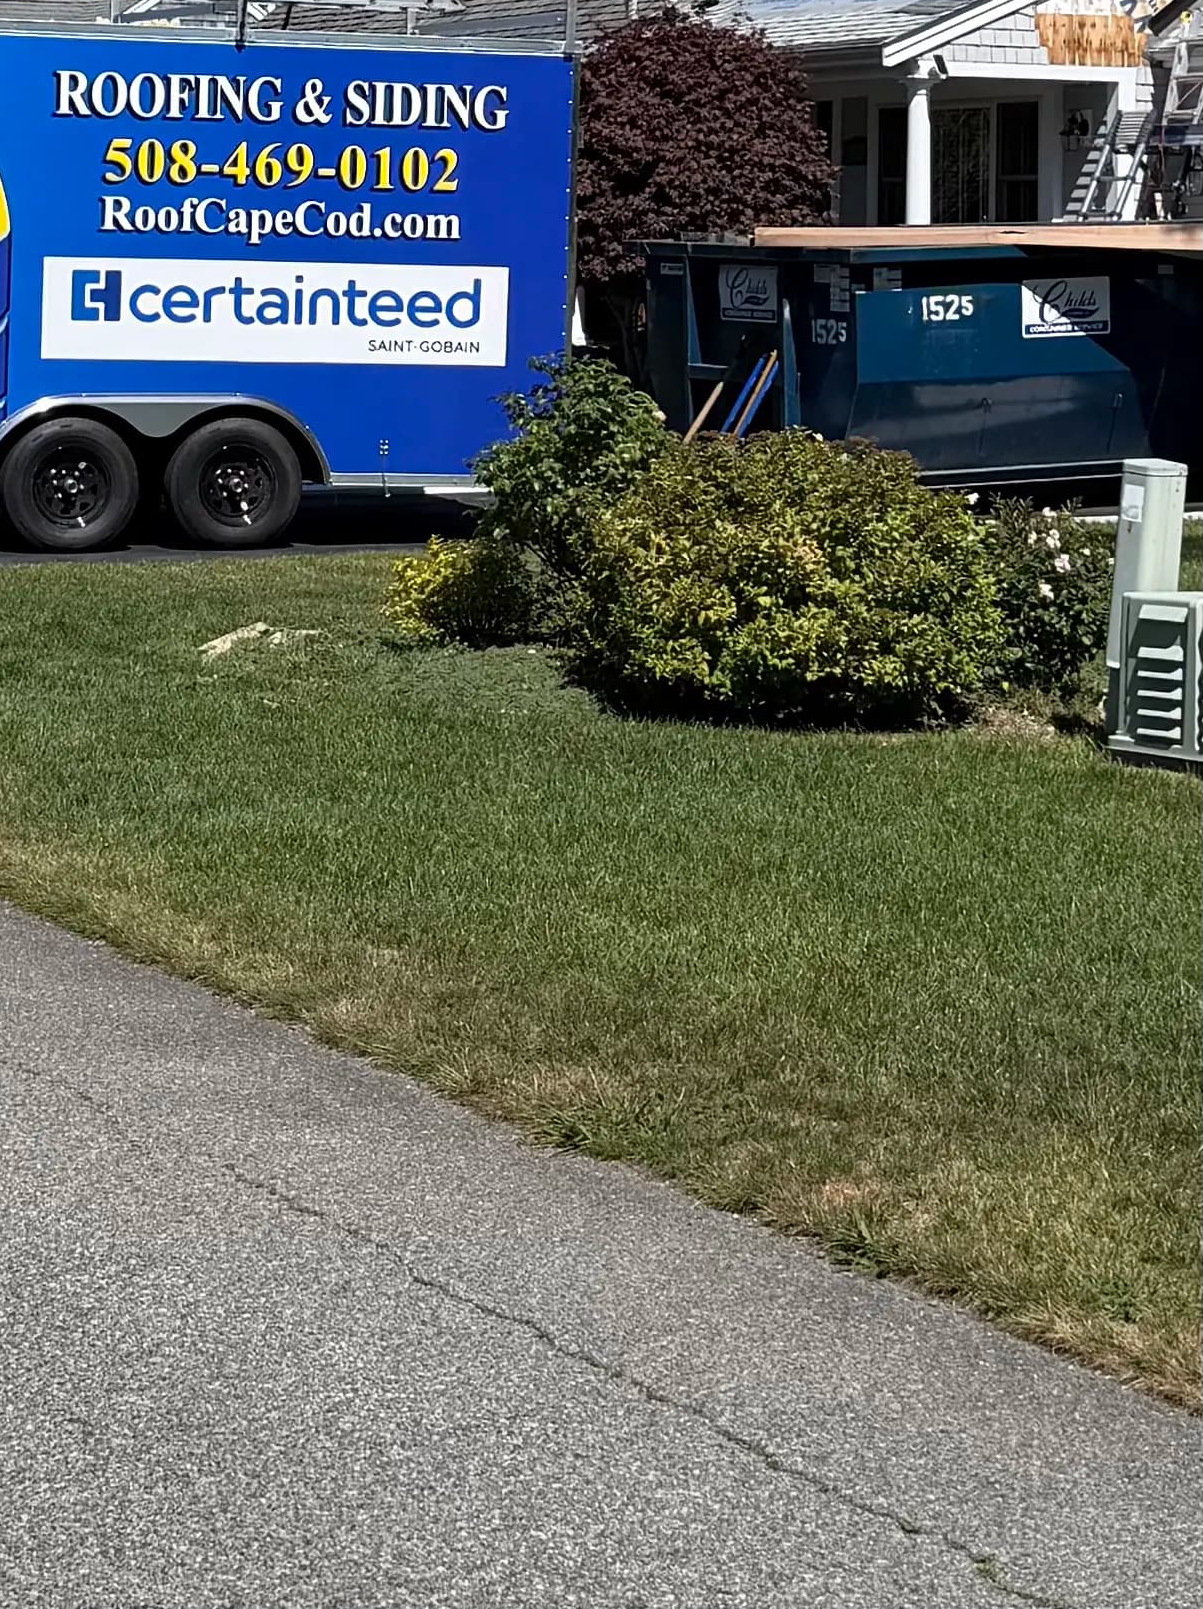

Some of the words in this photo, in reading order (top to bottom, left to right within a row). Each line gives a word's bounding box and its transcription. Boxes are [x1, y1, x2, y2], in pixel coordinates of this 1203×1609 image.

[53, 70, 284, 122] ROOFING
[294, 78, 333, 125] &
[344, 80, 510, 130] SIDING
[103, 138, 459, 192] 508-469-0102
[99, 195, 462, 244] RoofCapeCod.com
[129, 275, 482, 328] certainteed
[922, 294, 974, 321] 1525
[811, 318, 847, 345] 1525
